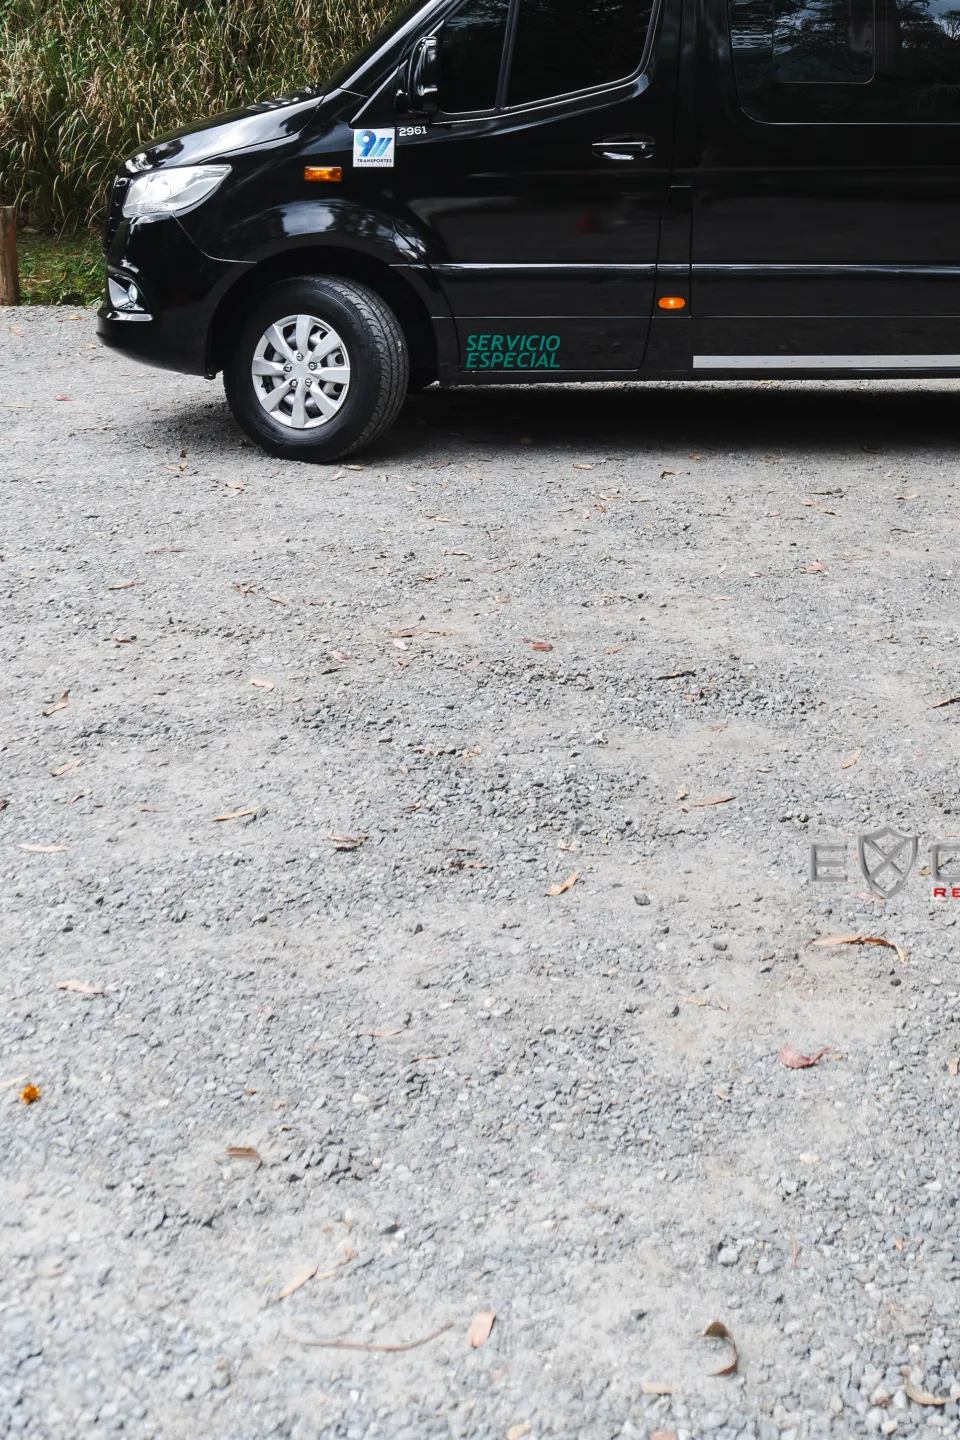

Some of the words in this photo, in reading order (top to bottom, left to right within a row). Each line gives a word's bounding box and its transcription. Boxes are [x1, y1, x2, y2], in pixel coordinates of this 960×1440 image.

[399, 126, 427, 137] 2961
[465, 334, 561, 351] SERVICIO
[465, 352, 561, 368] ESPECIAL
